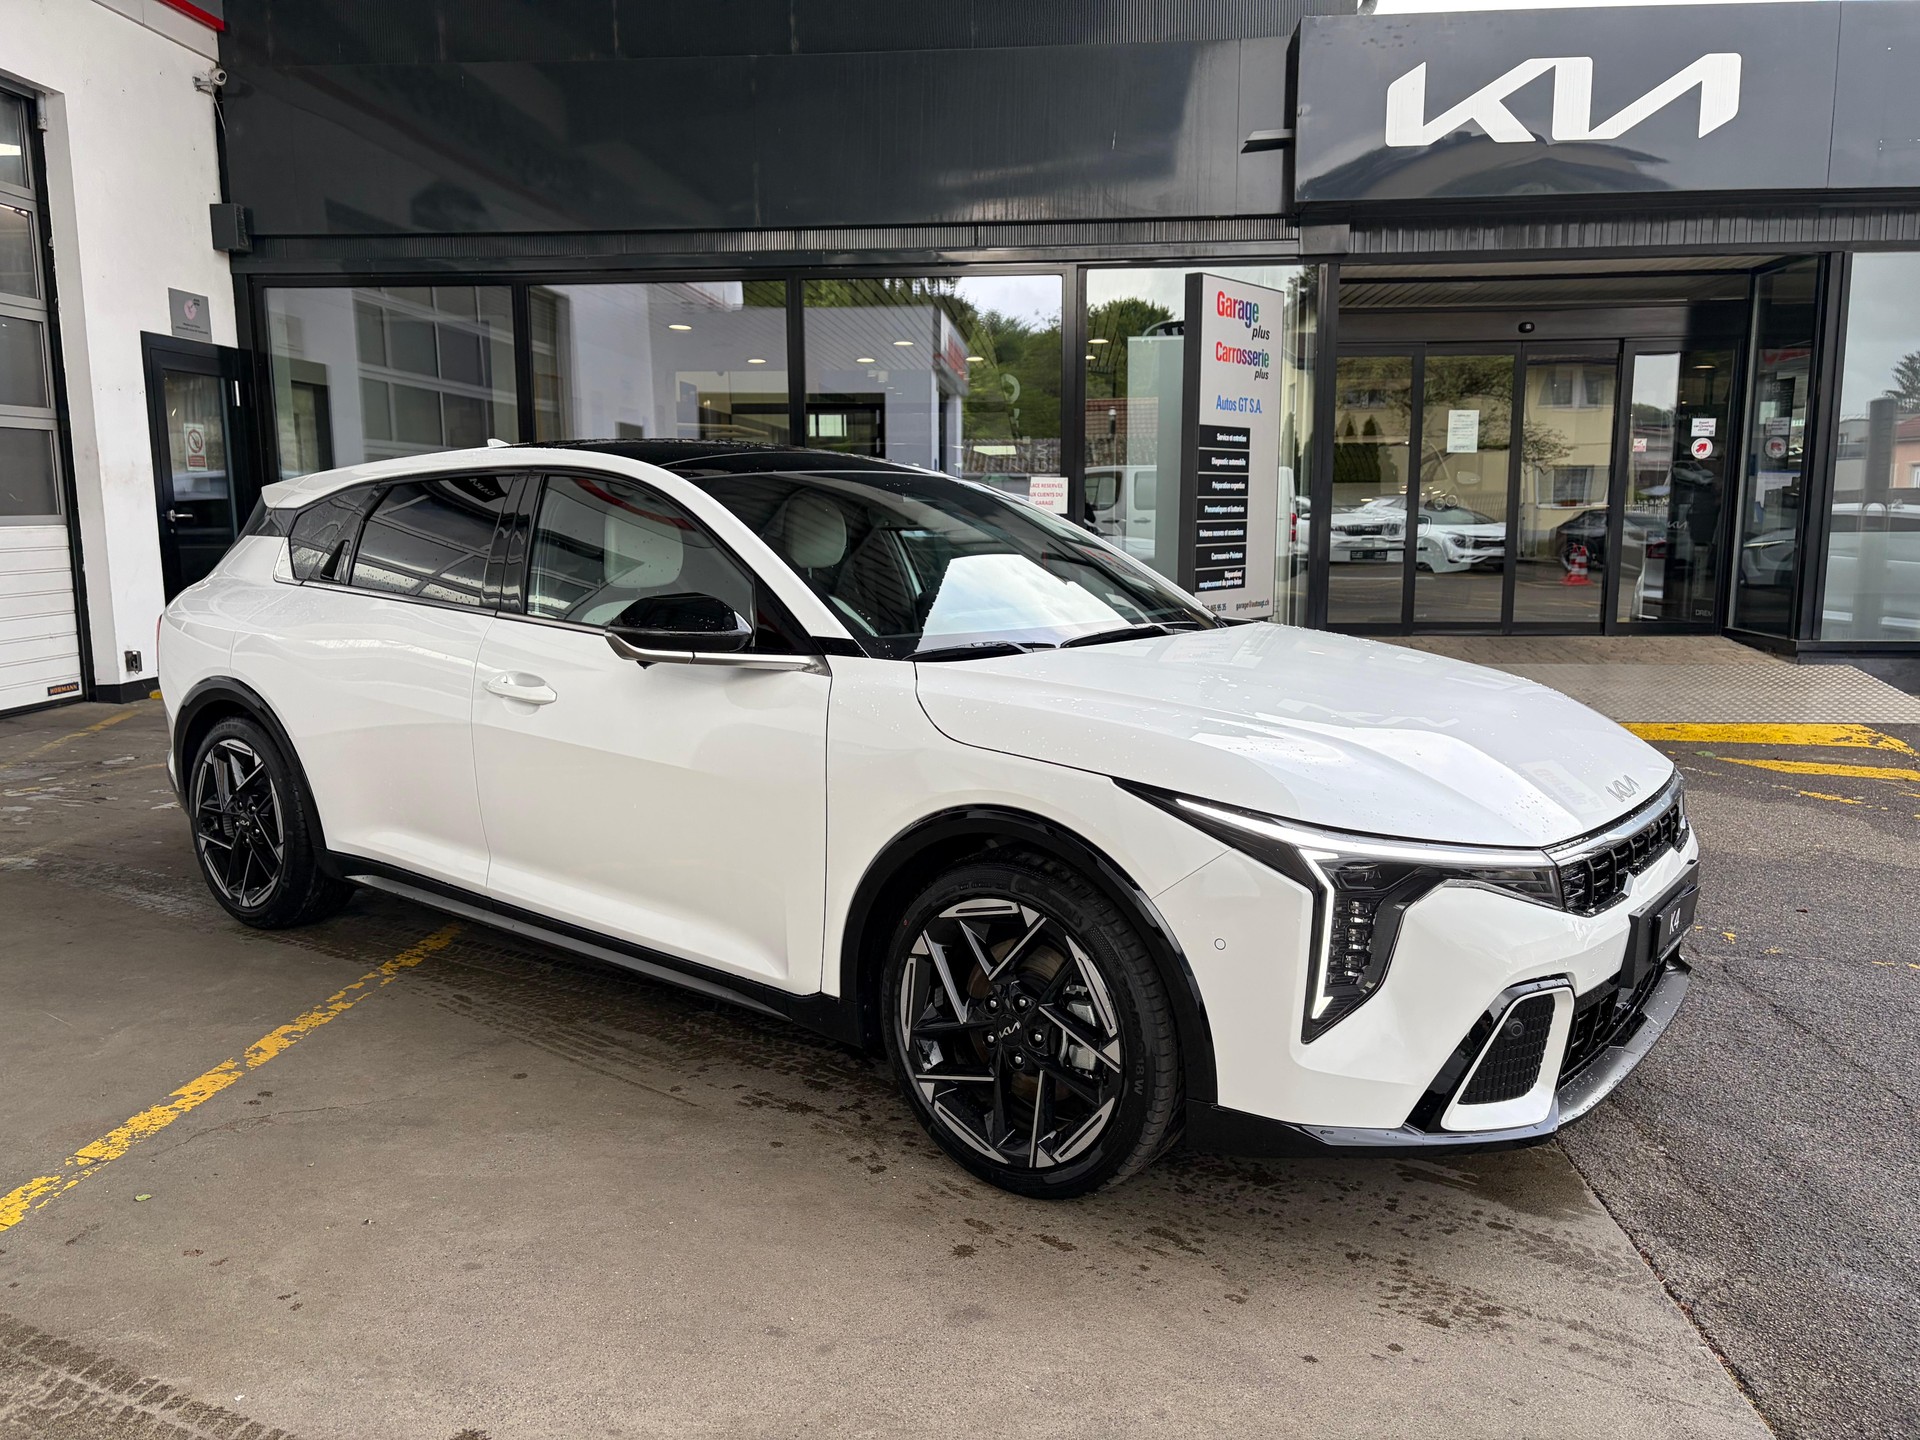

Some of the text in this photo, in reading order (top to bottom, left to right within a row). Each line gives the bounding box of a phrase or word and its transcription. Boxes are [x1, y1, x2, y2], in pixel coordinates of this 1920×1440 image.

[1385, 52, 1742, 147] KIA
[1216, 290, 1259, 329] Garage
[1251, 325, 1270, 341] plus
[1215, 341, 1270, 368] Carrosserie
[1254, 368, 1269, 381] plus
[1216, 394, 1262, 414] Autos GT S.A.
[1216, 433, 1229, 441] Service
[1668, 907, 1681, 935] K4
